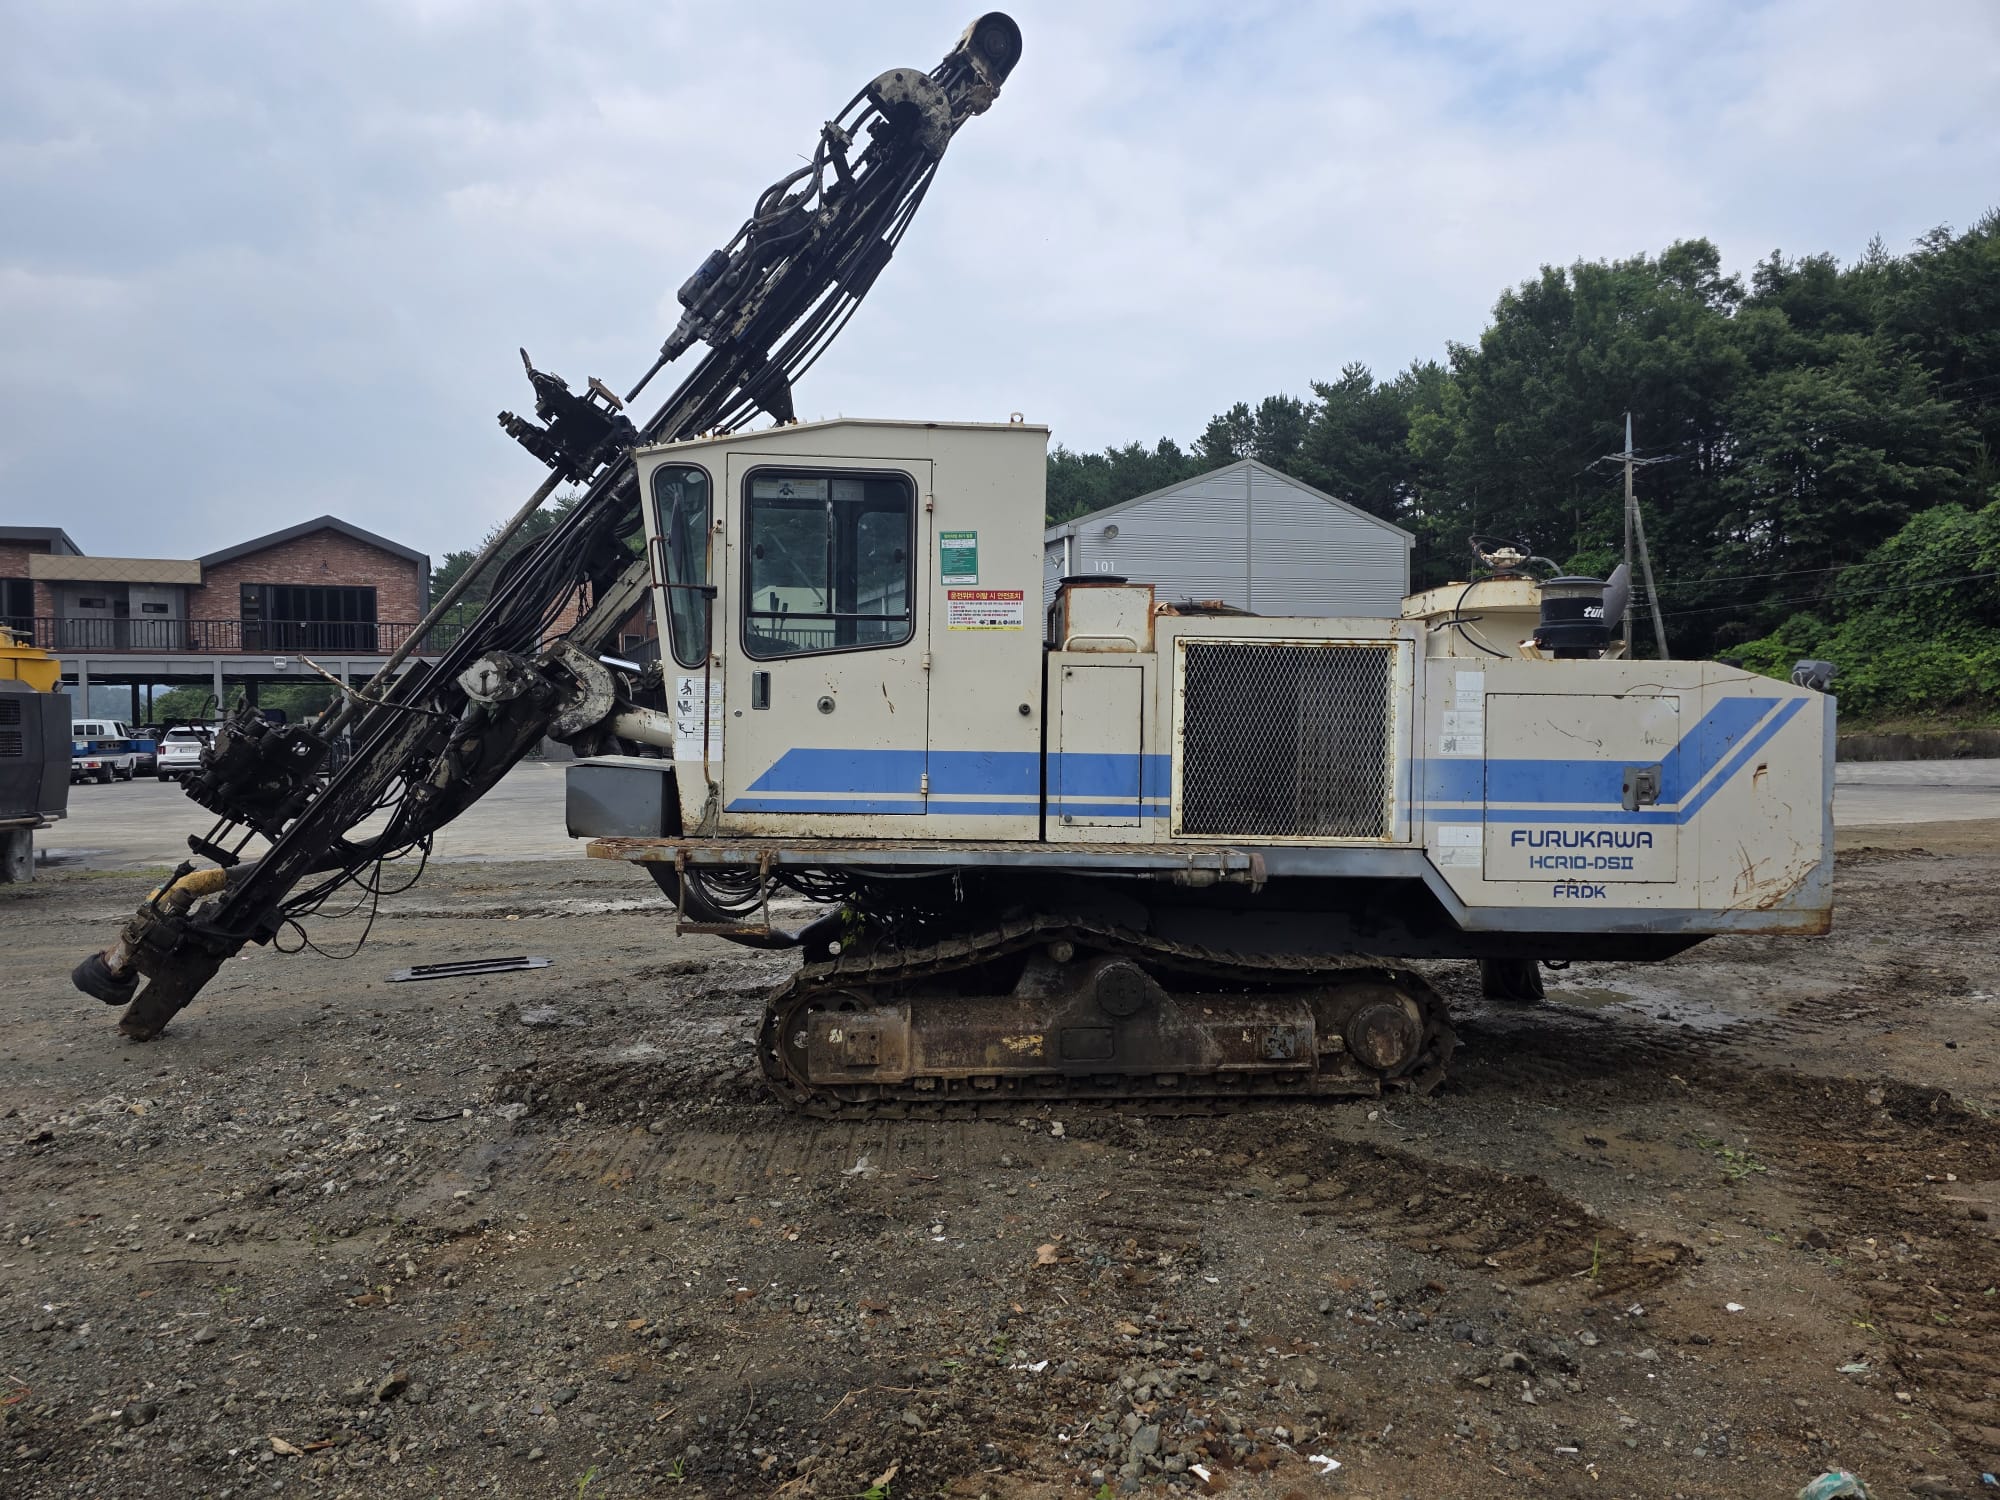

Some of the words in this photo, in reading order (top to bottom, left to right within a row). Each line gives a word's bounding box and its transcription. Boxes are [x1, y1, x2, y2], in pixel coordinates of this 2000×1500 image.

[1095, 561, 1114, 572] 101
[989, 592, 996, 600] 시
[1511, 830, 1653, 848] FURUKAWA
[1553, 885, 1607, 898] FRDK
